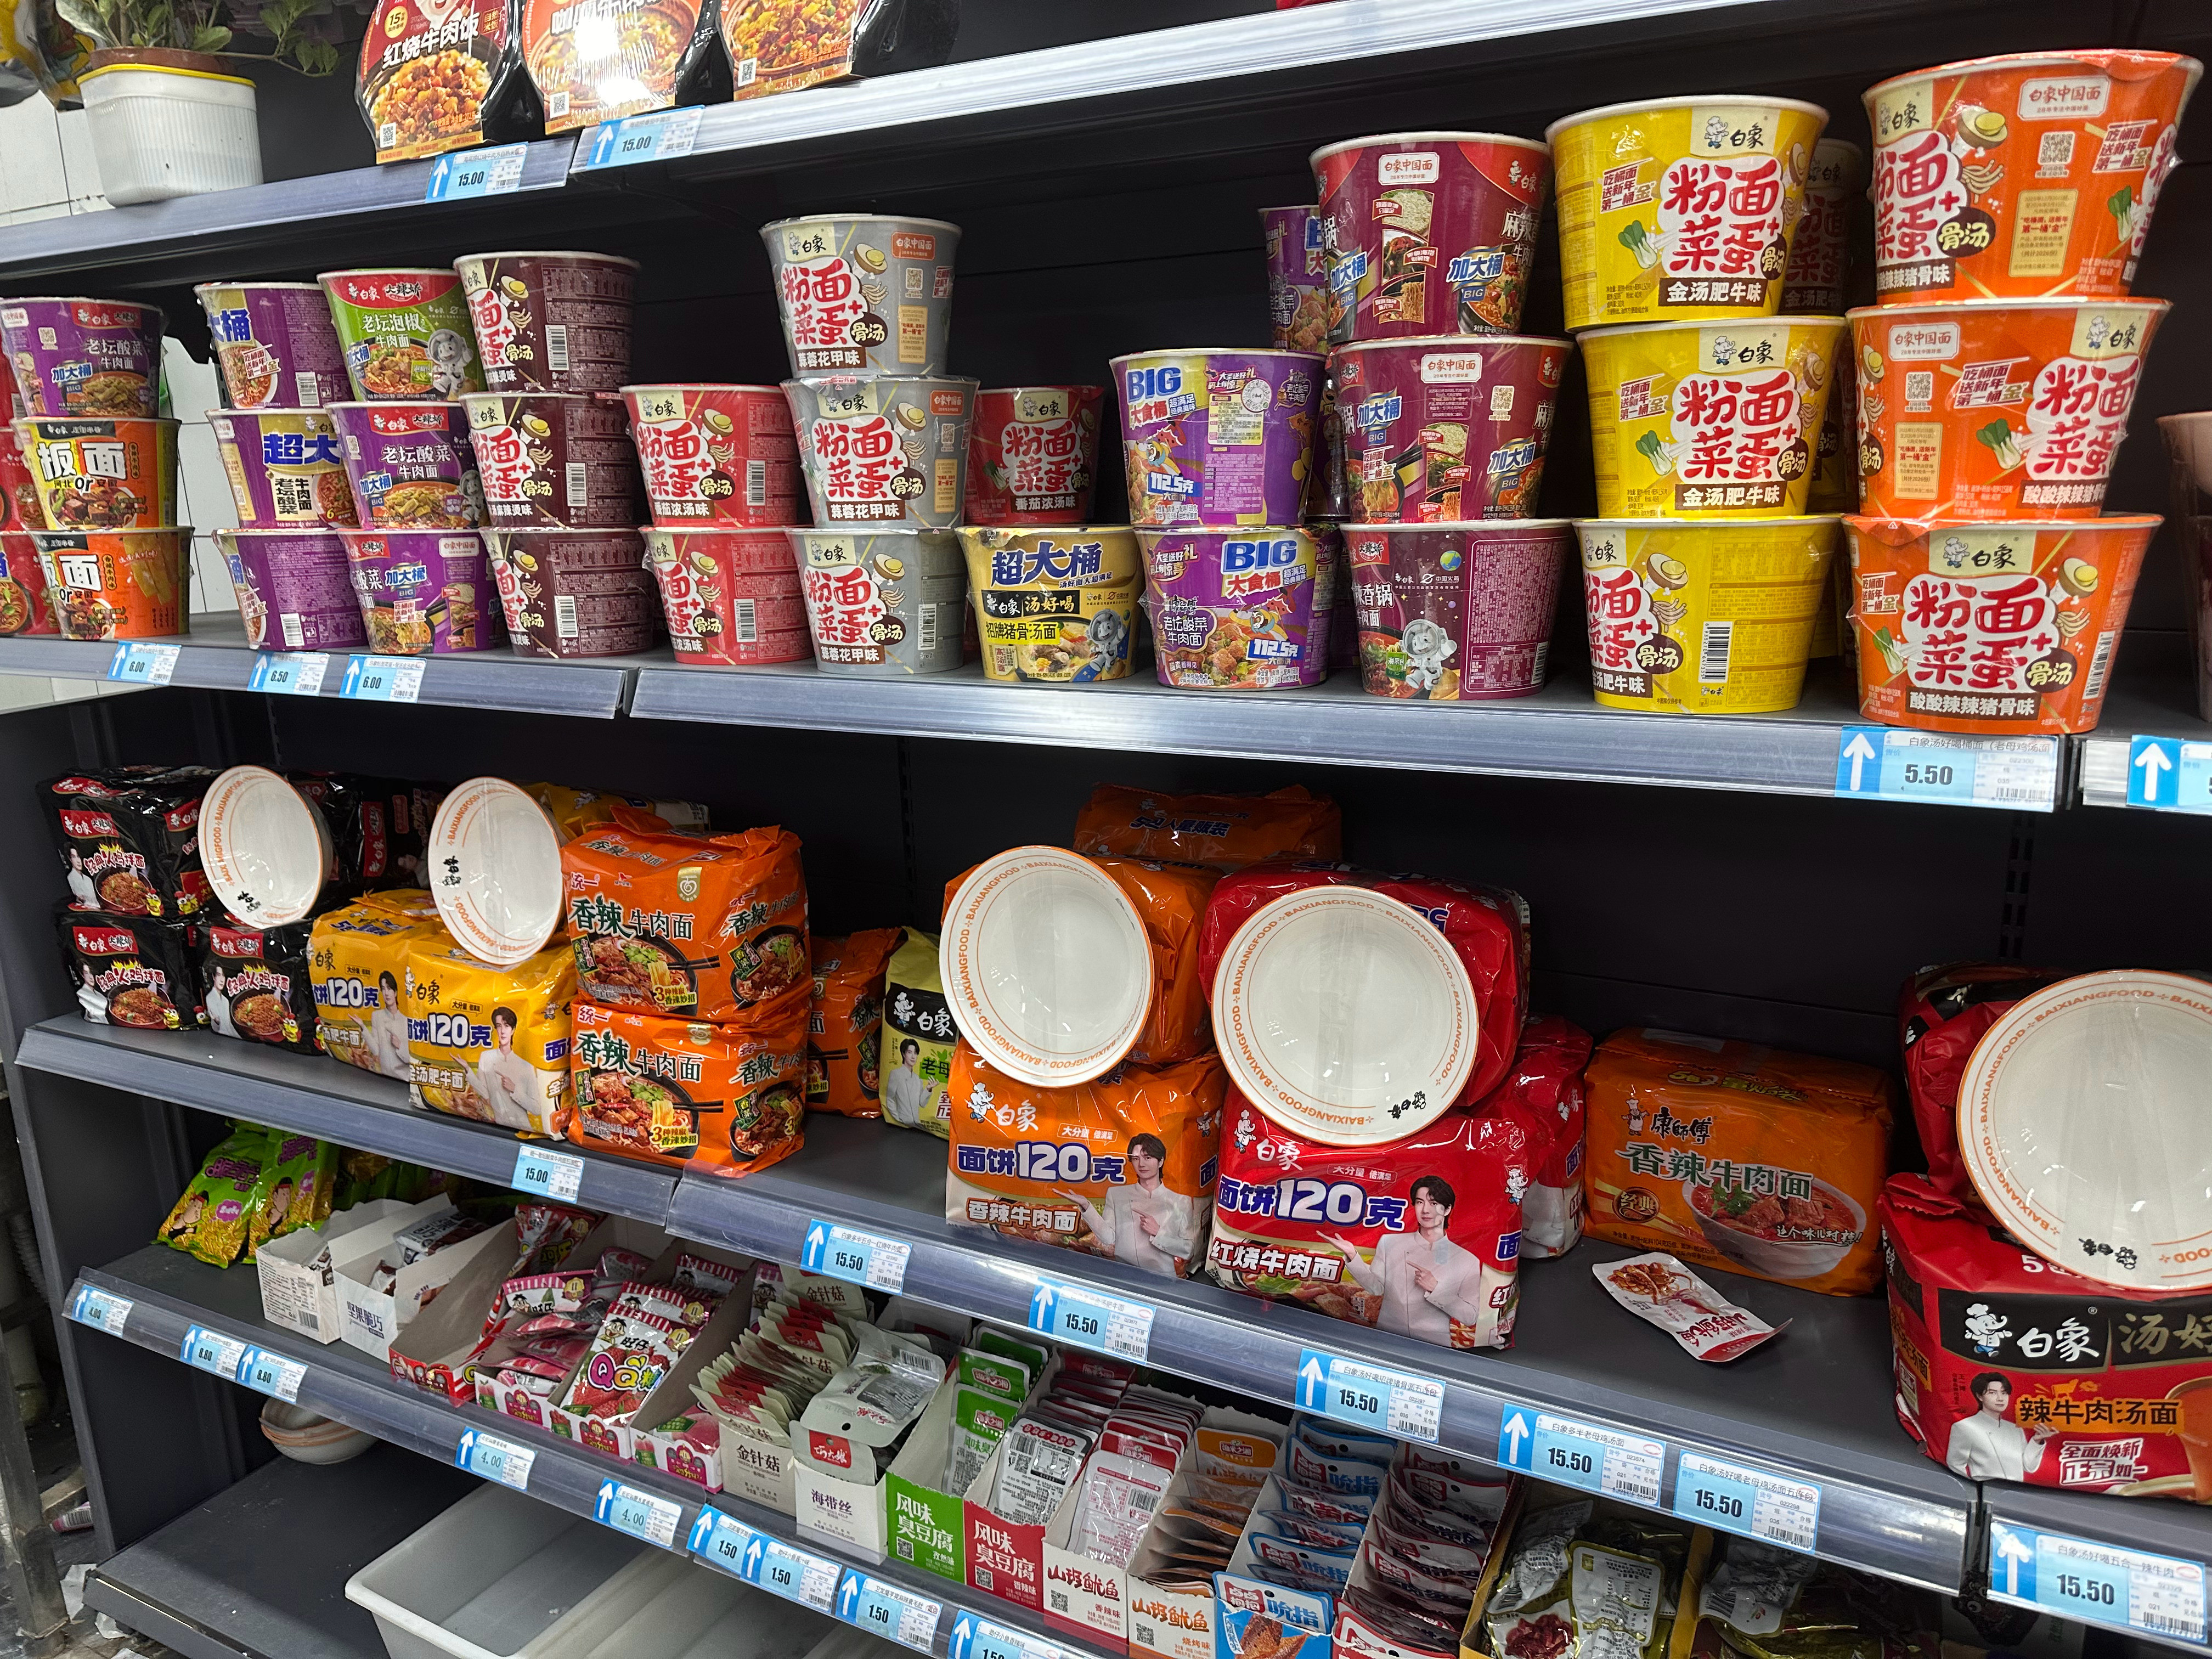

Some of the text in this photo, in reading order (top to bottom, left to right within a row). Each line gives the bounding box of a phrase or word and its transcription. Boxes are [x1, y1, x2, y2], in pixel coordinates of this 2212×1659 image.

[382, 12, 481, 69] 红烧牛肉饭
[2029, 84, 2102, 102] 白象中国面
[1892, 101, 1920, 131] 白象
[622, 136, 652, 153] 15.00
[1730, 123, 1764, 149] 白象
[1385, 160, 1432, 172] 白象中国面
[458, 171, 484, 187] 15.00
[1663, 159, 1779, 216] 粉面
[802, 234, 826, 253] 白象
[896, 237, 932, 250] 白象中国面
[1938, 221, 1989, 250] 骨汤
[1447, 252, 1505, 282] 加大桶
[1761, 245, 1785, 274] 骨汤
[781, 259, 851, 303] 粉面
[1667, 281, 1762, 303] 金汤肥牛味
[360, 286, 380, 301] 白象
[1340, 294, 1354, 304] BIG
[1463, 289, 1483, 299] BIG
[362, 313, 431, 333] 老坛泡椒
[851, 322, 884, 342] 骨汤
[85, 338, 143, 355] 老坛酸菜
[375, 334, 410, 349] 牛肉面
[1894, 330, 1951, 346] 白象中国面
[2109, 324, 2136, 348] 白象
[1737, 339, 1774, 364] 白象
[100, 357, 133, 369] 牛肉面
[1427, 359, 1476, 371] 白象中国面
[1675, 371, 1793, 426] 粉面
[2035, 358, 2140, 417] 粉面
[655, 399, 676, 416] 白象
[842, 393, 868, 411] 白象
[934, 396, 962, 407] 白象中国面
[1039, 400, 1060, 416] 白象
[1169, 394, 1195, 408] 超满足
[1358, 396, 1401, 427] 加大桶
[480, 407, 498, 422] 白象
[1131, 400, 1168, 425] 大食桶
[387, 419, 409, 431] 白象
[637, 422, 700, 460] 粉面
[814, 417, 891, 459] 粉面
[1005, 422, 1076, 457] 粉面
[1368, 432, 1384, 443] BIG
[263, 433, 341, 466] 超大
[1488, 443, 1536, 474] 加大桶
[1778, 448, 1807, 473] 骨汤
[37, 442, 127, 481] 板面
[398, 465, 438, 480] 牛肉面
[75, 477, 93, 494] or
[523, 480, 552, 496] 骨汤
[701, 479, 733, 495] 骨汤
[890, 477, 924, 495] 骨汤
[1071, 472, 1090, 487] 骨汤
[1150, 472, 1194, 493] 112.5克
[1502, 478, 1518, 488] BIG
[296, 479, 312, 510] 牛肉面
[1015, 495, 1076, 509] 番茄浓汤味
[1683, 486, 1780, 507] 金汤肥牛味
[654, 502, 709, 516] 番茄浓汤味
[824, 544, 847, 561] 白象
[1224, 540, 1296, 573] BIG
[1971, 544, 2016, 569] 白象
[991, 541, 1102, 587] 超大桶
[1283, 566, 1306, 577] 超满足
[805, 567, 871, 606] 粉面
[1227, 572, 1282, 595] 大食桶
[59, 588, 72, 603] or
[1025, 596, 1075, 613] 汤好喝
[1907, 578, 2046, 634] 粉面
[520, 613, 544, 628] 骨汤
[695, 617, 722, 633] 骨汤
[871, 623, 903, 640] 骨汤
[986, 622, 1057, 640] 招牌猪骨汤面
[1164, 616, 1208, 631] 老坛酸菜
[1167, 631, 1203, 646] 牛肉面
[1254, 639, 1299, 657] 112.5克
[821, 646, 879, 662] 蒜蓉花甲味
[1637, 645, 1679, 668] 骨汤
[271, 670, 288, 683] 6.50
[363, 676, 382, 689] 6.00
[2026, 660, 2073, 686] 骨汤
[1909, 691, 2034, 716] 酸酸辣辣猪骨味
[1905, 764, 1953, 786] 5.50
[447, 794, 480, 840] BAIXIANGFOOD
[84, 850, 146, 875] 经典火鸡拌面
[967, 866, 1020, 921] BAIXIANGFOOD
[569, 894, 694, 940] 香辣牛肉面
[1284, 900, 1375, 917] BAIXIANGFOOD
[1385, 910, 1453, 980] BAIXIANGFOOD
[1232, 919, 1278, 995] BAIXIANGFOOD
[95, 968, 166, 991] 经典火鸡拌面
[578, 1006, 610, 1024] 统一
[2035, 989, 2155, 1023] BAIXIANGFOOD
[917, 1007, 953, 1037] 白象
[1441, 990, 1462, 1079] BAIXIANGFOOD
[573, 1028, 704, 1082] 香辣牛肉面
[1232, 1005, 1273, 1089] BAIXIANGFOOD
[1980, 1028, 2026, 1124] BAIXIANGFOOD
[996, 1099, 1038, 1132] 白象
[1278, 1091, 1365, 1125] BAIXIANGFOOD
[957, 1141, 1126, 1183] 面饼120克
[1256, 1138, 1303, 1171] 白象
[525, 1166, 549, 1183] 15.00
[1333, 1164, 1365, 1178] 大分量
[1615, 1142, 1813, 1202] 香辣牛肉面
[1983, 1136, 2050, 1232] BAIXIANGFOOD
[1217, 1175, 1409, 1231] 面饼120克
[1620, 1192, 1655, 1212] 经典
[967, 1199, 1079, 1232] 香辣牛肉面
[836, 1251, 863, 1271] 15.50
[1210, 1239, 1343, 1283] 红烧牛肉面
[806, 1285, 845, 1302] 金针菇
[1066, 1313, 1098, 1335] 15.50
[620, 1336, 651, 1352] 旺仔
[2017, 1317, 2100, 1362] 白象
[589, 1353, 665, 1392] QQ糖
[1339, 1389, 1378, 1414] 15.50
[2018, 1399, 2180, 1426] 辣牛肉汤面
[481, 1451, 501, 1469] 4.00
[737, 1444, 780, 1473] 金针菇
[1548, 1447, 1592, 1474] 15.50
[2064, 1440, 2141, 1460] 全面焕新
[811, 1489, 853, 1516] 海带丝
[896, 1492, 935, 1526] 风味
[1695, 1488, 1742, 1518] 15.50
[622, 1509, 644, 1526] 4.00
[898, 1515, 953, 1554] 臭豆腐
[974, 1520, 1016, 1555] 风味
[719, 1539, 737, 1559] 1.50
[933, 1550, 955, 1566] 孜然味
[975, 1543, 1035, 1582] 臭豆腐
[772, 1567, 791, 1585] 1.50
[1013, 1581, 1036, 1596] 香辣味
[2057, 1574, 2115, 1605] 15.50
[869, 1604, 889, 1623] 1.50
[1095, 1604, 1121, 1618] 香辣味
[1267, 1599, 1319, 1628] 吮指
[1182, 1637, 1211, 1650] 烧烤味
